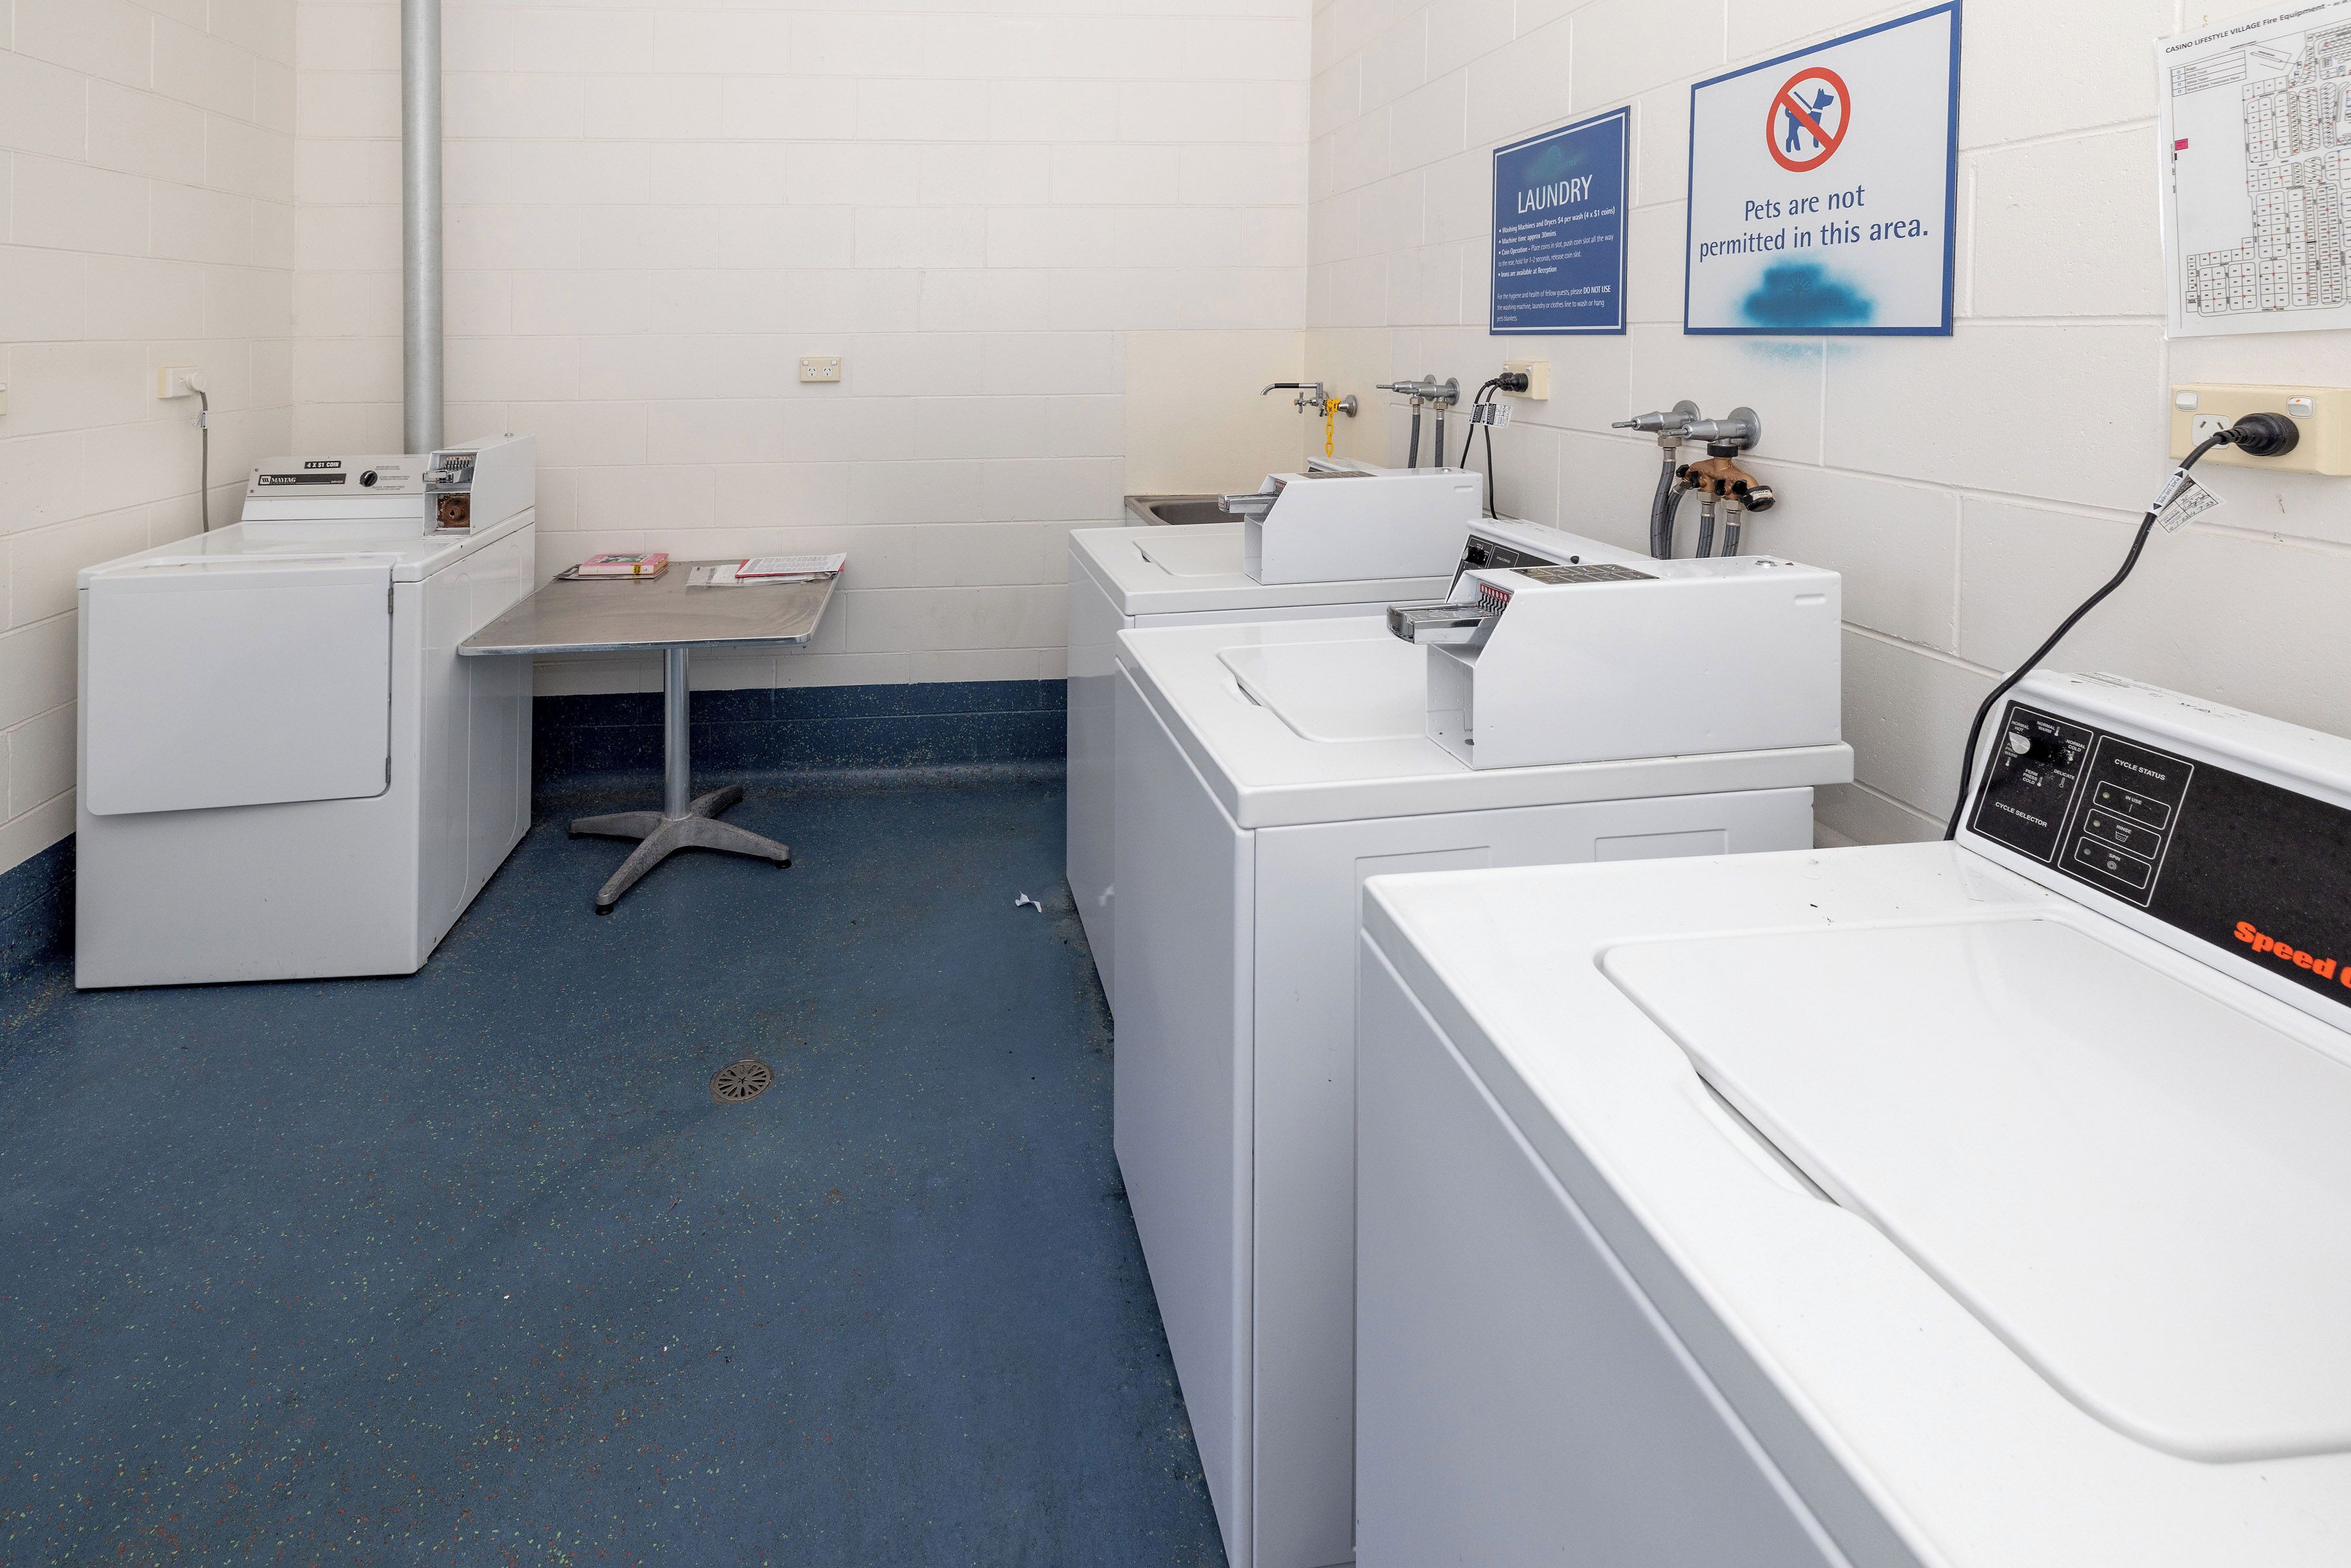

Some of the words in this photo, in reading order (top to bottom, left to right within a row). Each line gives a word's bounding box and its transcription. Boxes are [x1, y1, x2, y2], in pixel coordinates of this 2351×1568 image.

[2166, 42, 2192, 53] CASINO
[2194, 31, 2228, 46] LIFESTYLE
[2230, 22, 2261, 35] VILLAGE
[2263, 17, 2277, 25] Fire
[2280, 4, 2325, 20] Equipment
[1518, 174, 1592, 214] LAUNDRY
[1745, 199, 1781, 221] Pets
[1789, 195, 1819, 216] are
[1828, 185, 1865, 210] not
[1518, 222, 1535, 231] Machines
[1573, 212, 1583, 221] wash
[1584, 211, 1589, 219] (4
[1601, 206, 1615, 216] coins)
[1699, 228, 1785, 263] permitted
[1793, 227, 1811, 248] in
[1821, 219, 1860, 246] this
[1870, 217, 1928, 241] area.
[1510, 247, 1527, 255] Operation
[1563, 239, 1573, 248] push
[1538, 266, 1557, 274] Reception
[2011, 720, 2030, 730] NORMAL
[2037, 721, 2056, 730] NORMAL
[2066, 739, 2086, 749] NORMAL
[2004, 750, 2017, 759] WARM
[2054, 769, 2075, 780] DELICATE
[2115, 759, 2137, 771] CYCLE
[2138, 767, 2166, 780] STATUS
[2023, 773, 2038, 781] PRESS
[1995, 801, 2015, 814] CYCLE
[2015, 810, 2047, 827] SELECTOR
[2116, 824, 2132, 834] RINSE
[2109, 853, 2120, 861] SPIN
[2233, 921, 2337, 980] Speed
